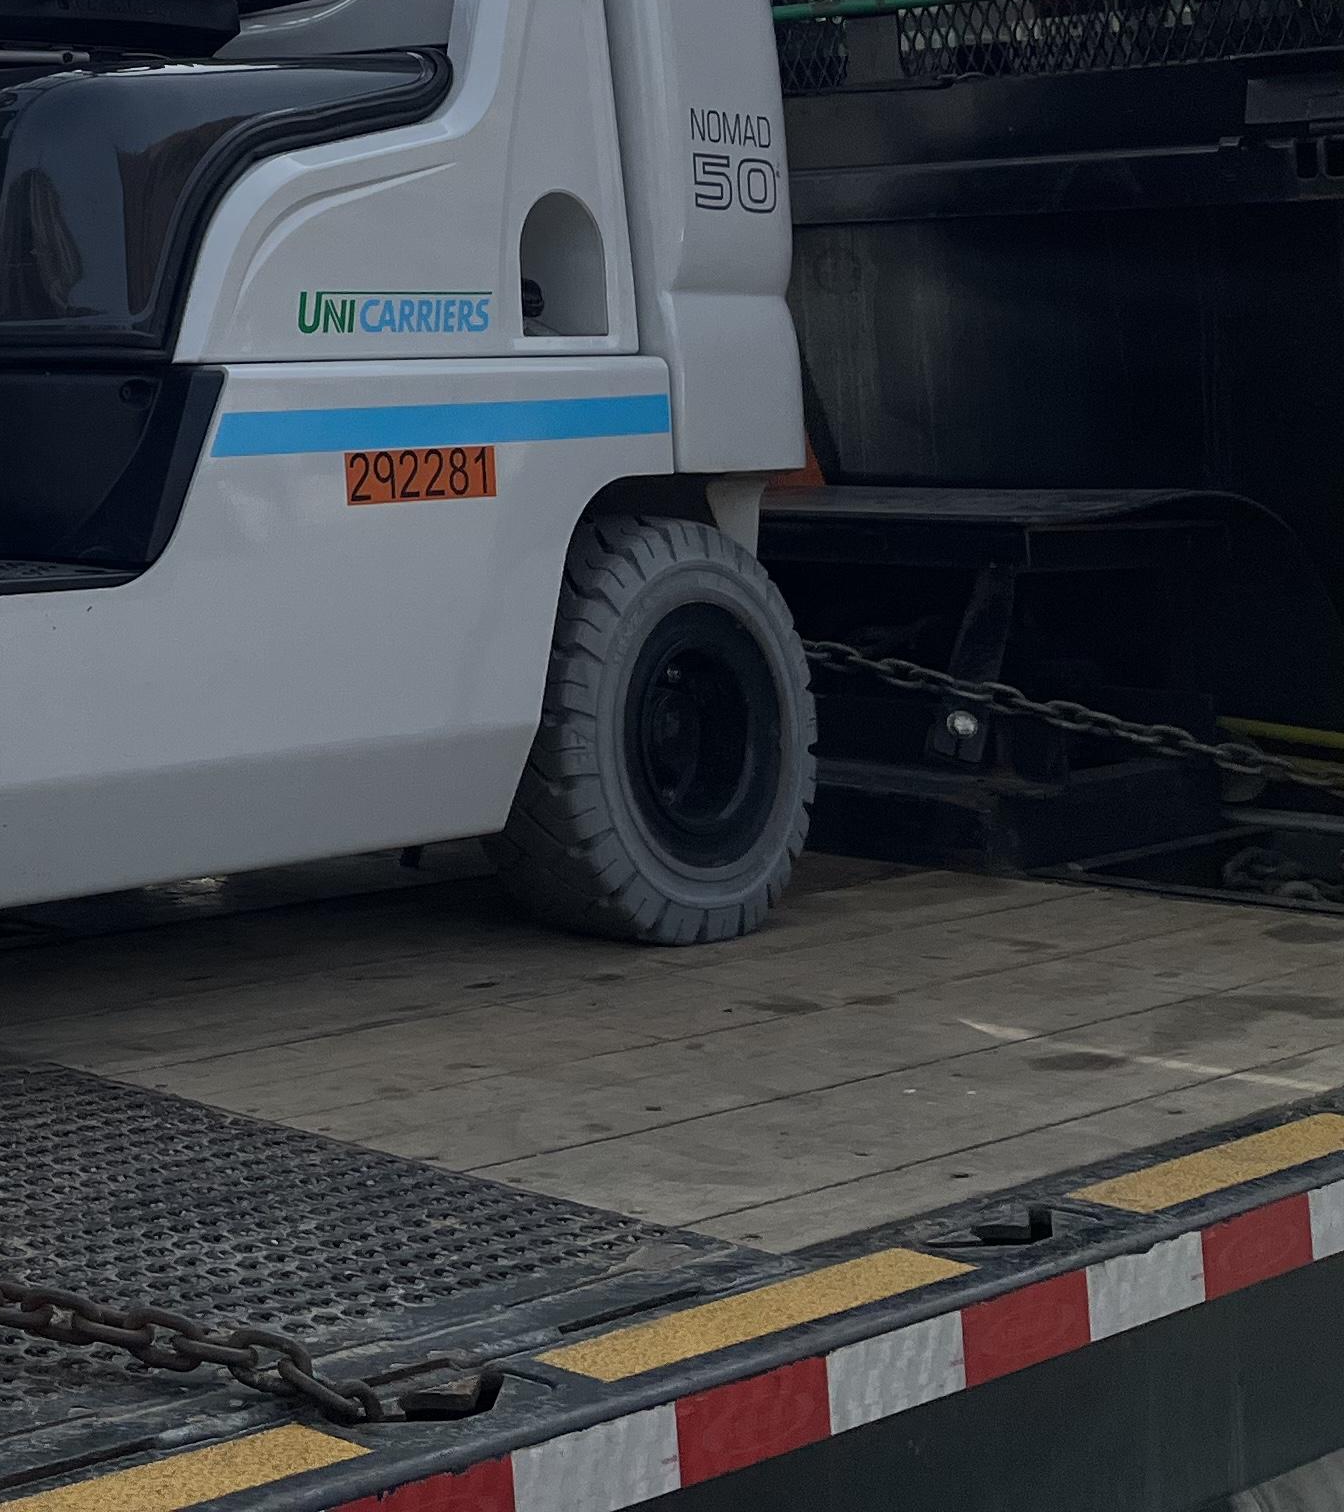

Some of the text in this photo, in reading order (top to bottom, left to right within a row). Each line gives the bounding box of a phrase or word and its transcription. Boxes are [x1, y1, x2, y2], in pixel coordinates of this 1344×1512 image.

[690, 107, 772, 149] NOMAD
[692, 152, 777, 214] 50
[298, 290, 493, 334] UNICARRIERS
[349, 446, 489, 502] 292281
